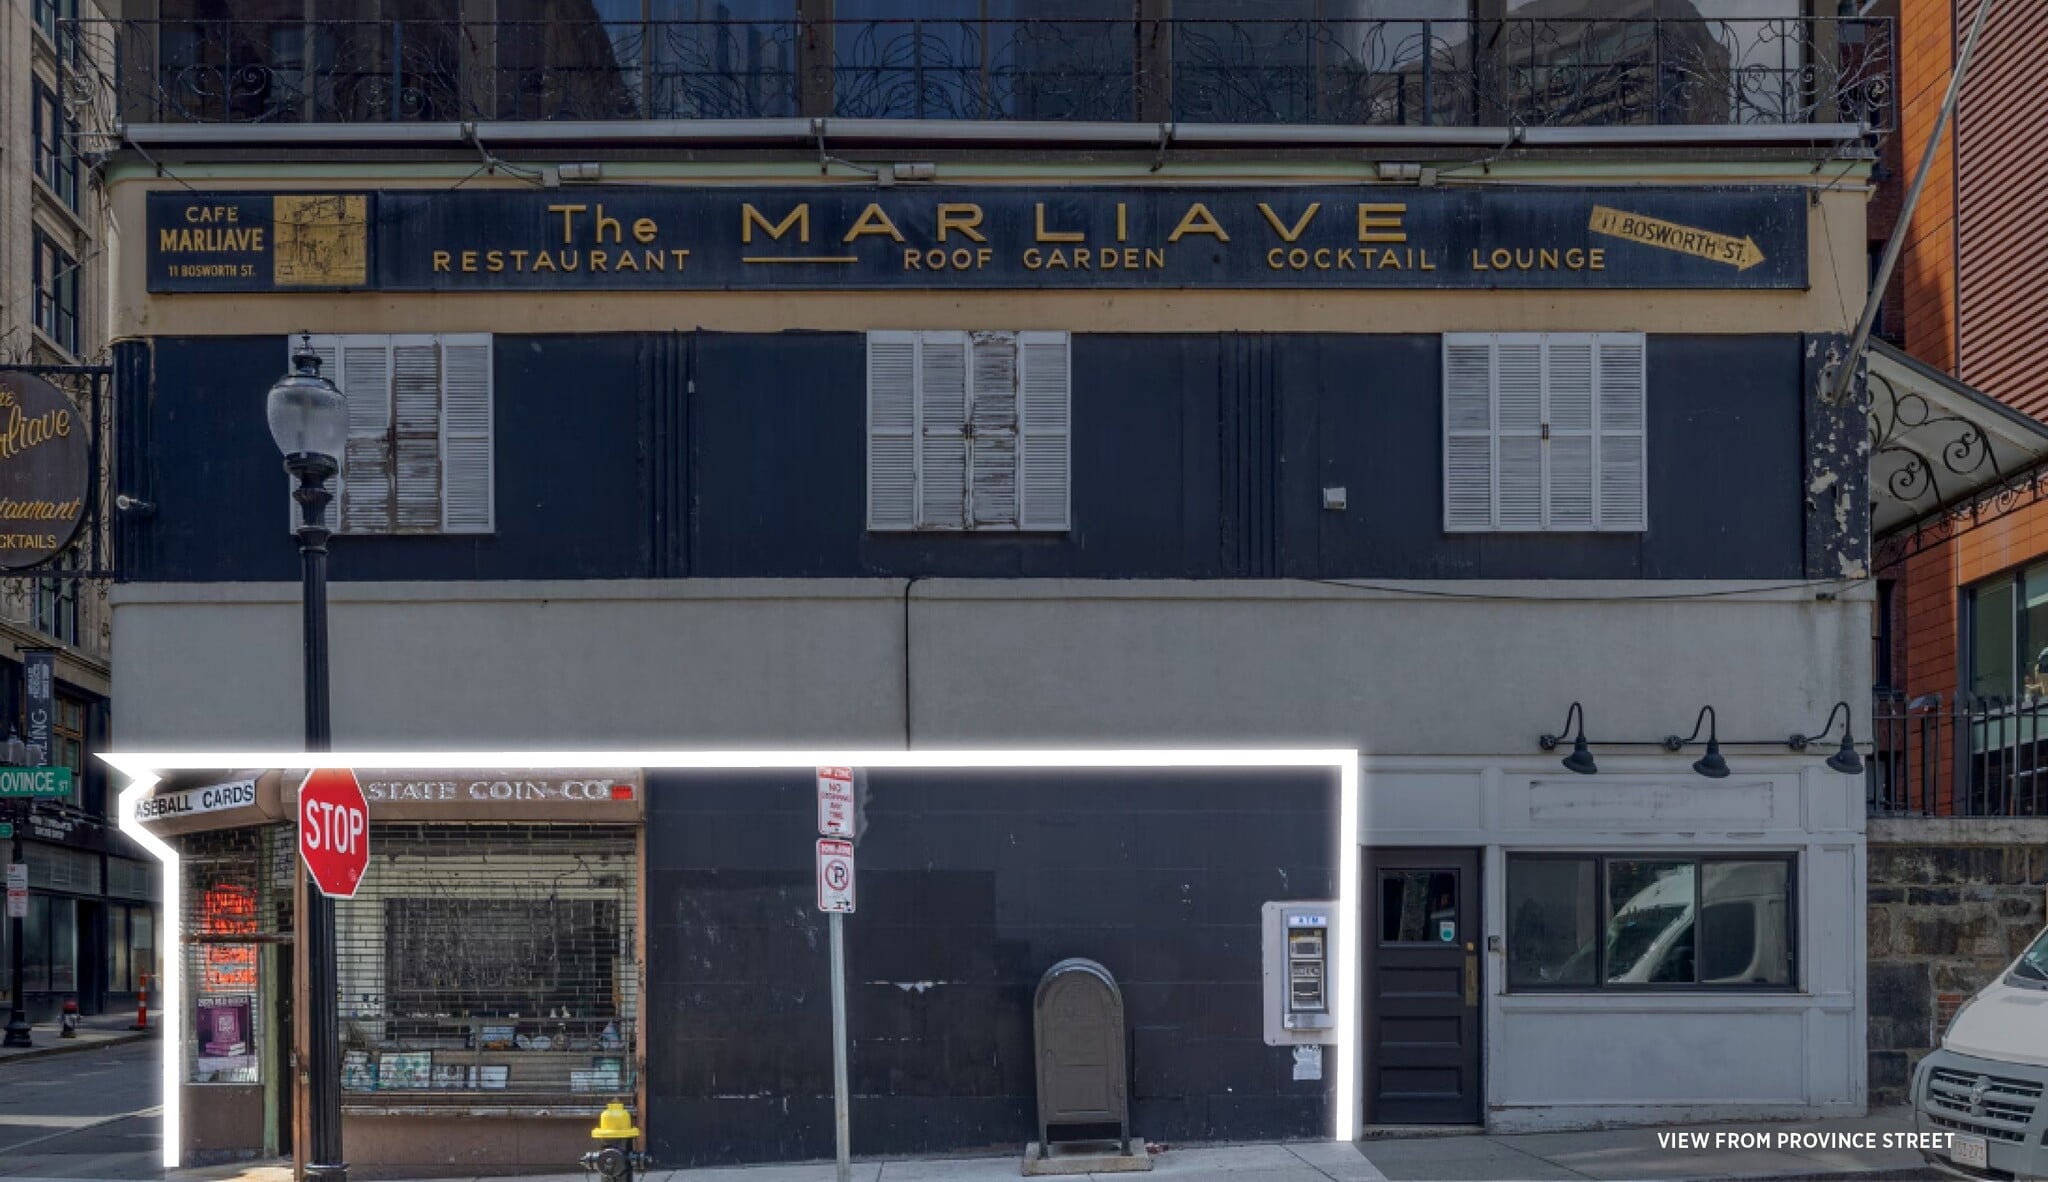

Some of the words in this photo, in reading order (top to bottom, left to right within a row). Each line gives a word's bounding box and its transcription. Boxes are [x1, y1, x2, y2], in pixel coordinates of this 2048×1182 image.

[186, 206, 239, 223] CAFE
[548, 203, 659, 243] The
[742, 202, 1408, 243] MARLIAVE
[160, 228, 265, 252] MARLIAVE
[1622, 217, 1717, 256] BOSWORTH
[168, 264, 179, 277] 11
[181, 264, 238, 278] BOSWORTH
[432, 249, 690, 273] RESTAURANT
[903, 247, 994, 271] ROOF
[1022, 247, 1166, 270] GARDEN
[1267, 247, 1436, 271] COCKTAIL
[1472, 247, 1606, 270] LOUNGE
[202, 784, 254, 809] CARDS
[368, 781, 458, 800] STATE
[828, 783, 841, 792] NO
[305, 798, 364, 856] STOP
